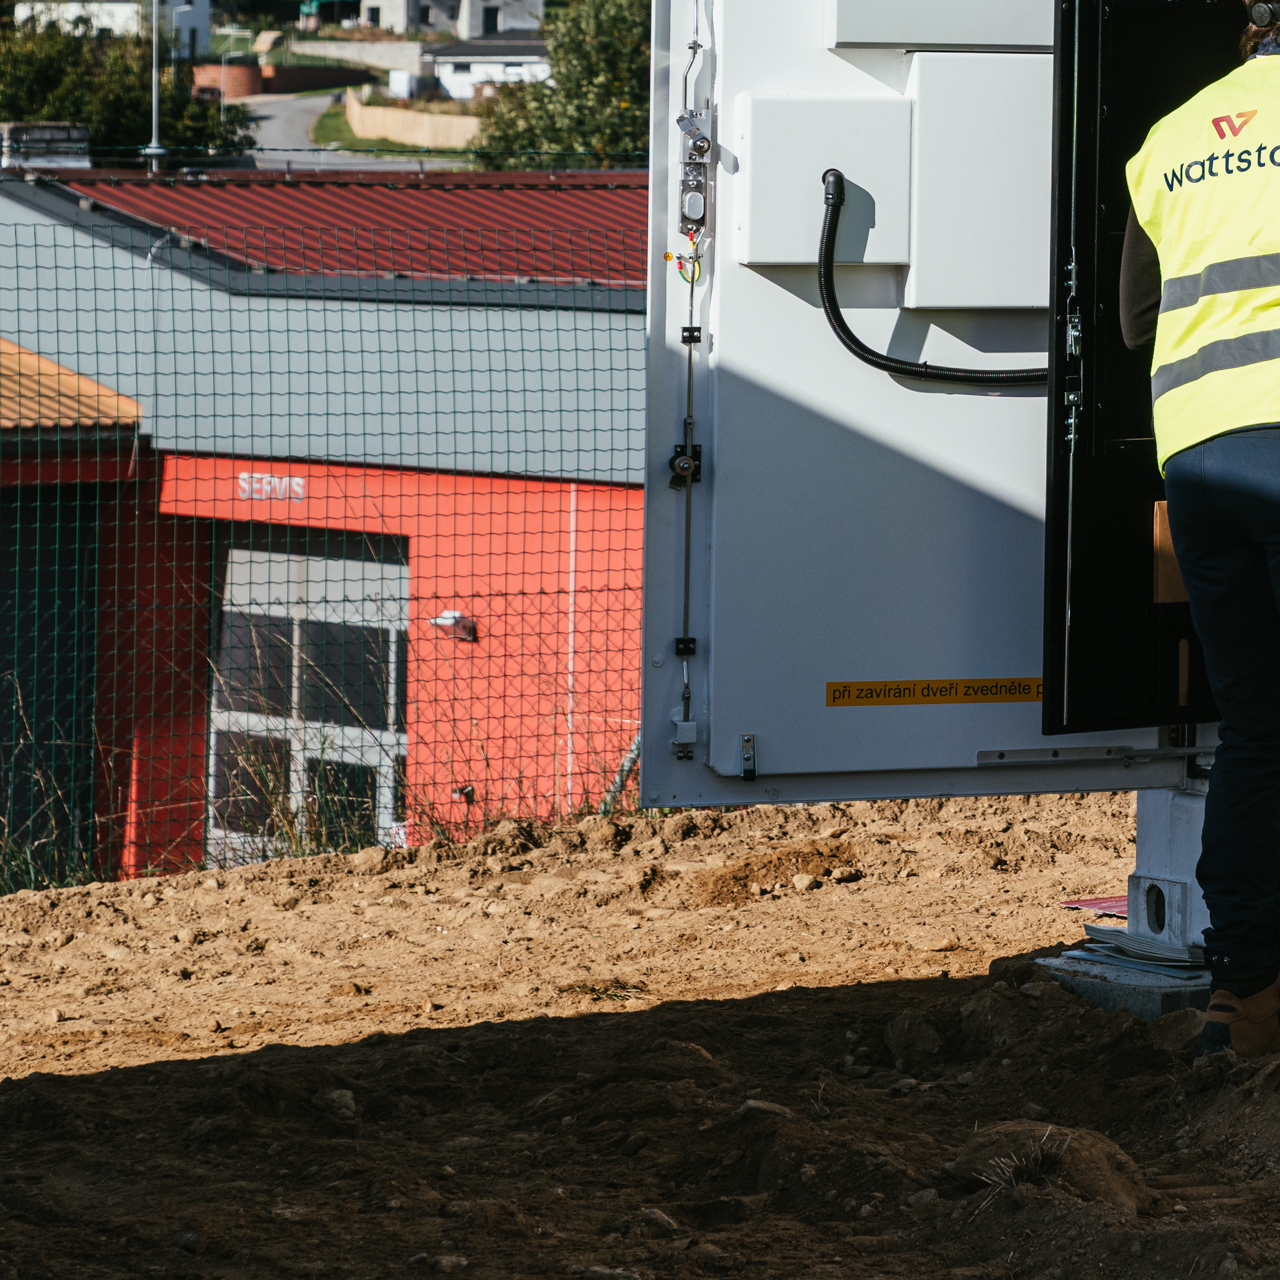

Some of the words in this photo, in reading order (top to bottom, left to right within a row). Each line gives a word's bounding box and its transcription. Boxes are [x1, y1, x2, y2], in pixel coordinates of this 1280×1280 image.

[238, 472, 305, 503] SERVIS
[832, 685, 851, 703] při
[855, 683, 917, 700] zavírání
[921, 682, 959, 697] dveří
[963, 681, 1032, 697] zvedněte
